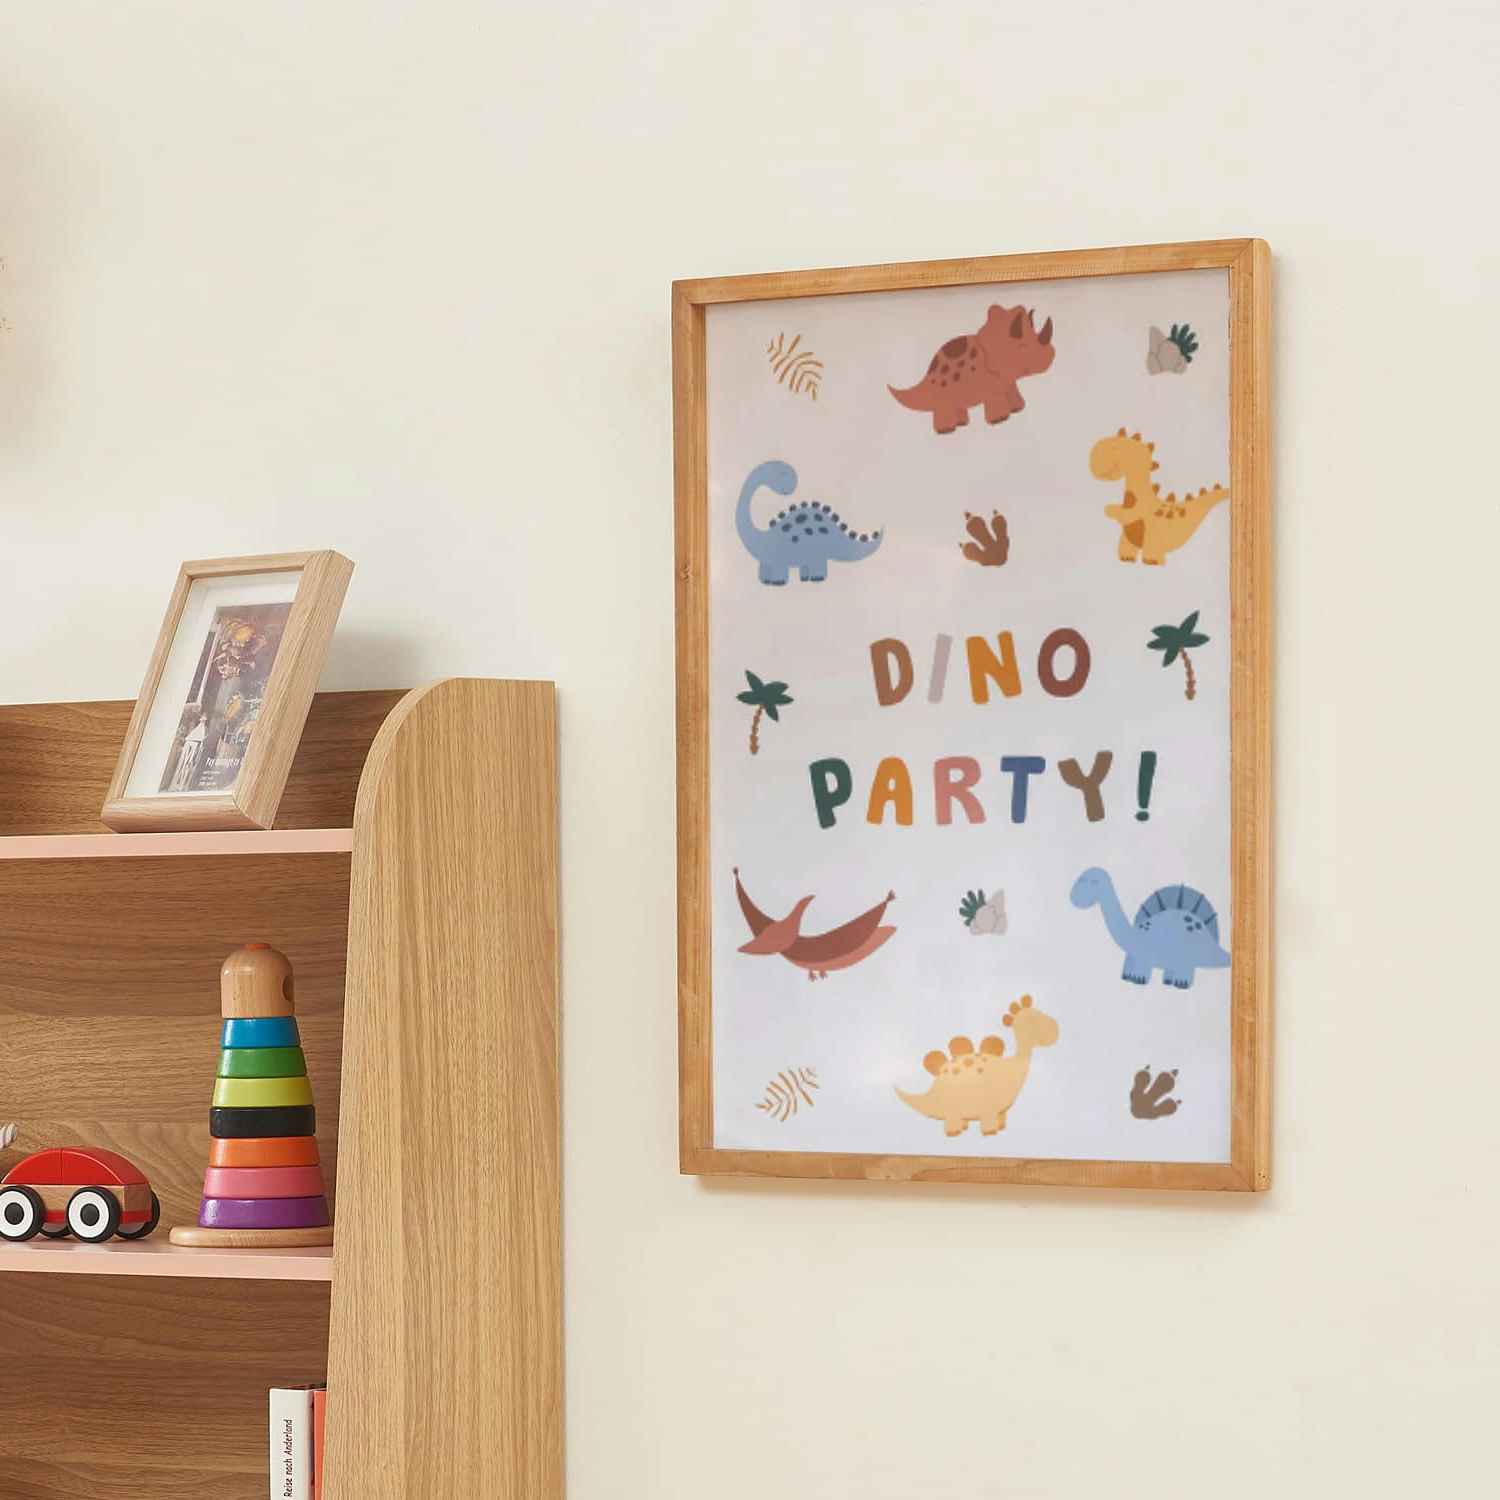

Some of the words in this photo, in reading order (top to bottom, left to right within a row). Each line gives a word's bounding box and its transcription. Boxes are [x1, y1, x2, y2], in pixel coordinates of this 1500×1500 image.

[869, 627, 1092, 706] DINO
[808, 750, 1157, 829] PARTY!
[283, 1419, 293, 1456] Anderland
[283, 1458, 293, 1475] nach
[284, 1478, 293, 1497] Reise
